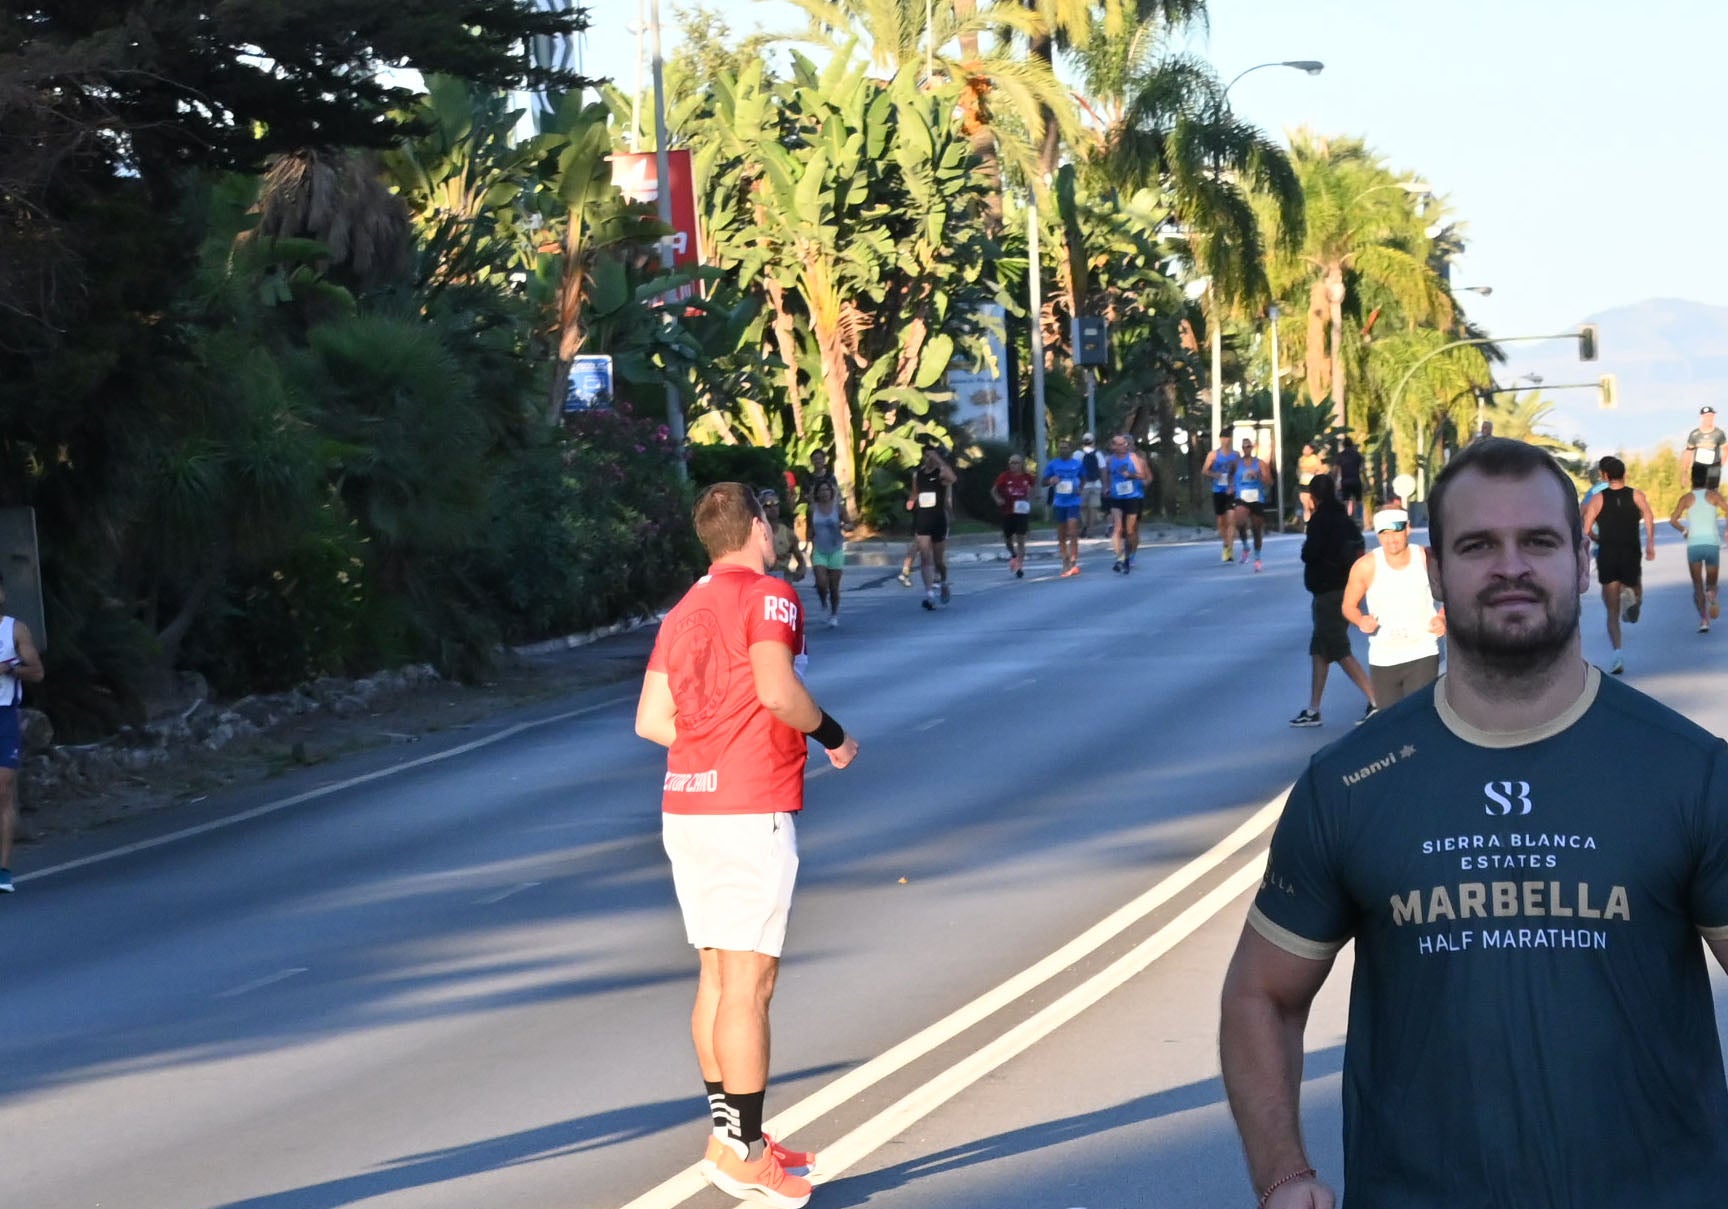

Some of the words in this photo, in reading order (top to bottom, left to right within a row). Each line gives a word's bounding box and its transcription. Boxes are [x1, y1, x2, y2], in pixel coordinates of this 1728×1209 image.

[1422, 835, 1501, 855] SIERRA
[1510, 834, 1598, 851] BLANCA
[1461, 855, 1557, 870] ESTATES
[1390, 880, 1632, 927] MARBELLA
[1419, 931, 1473, 955] HALF
[1482, 929, 1608, 950] MARATHON
